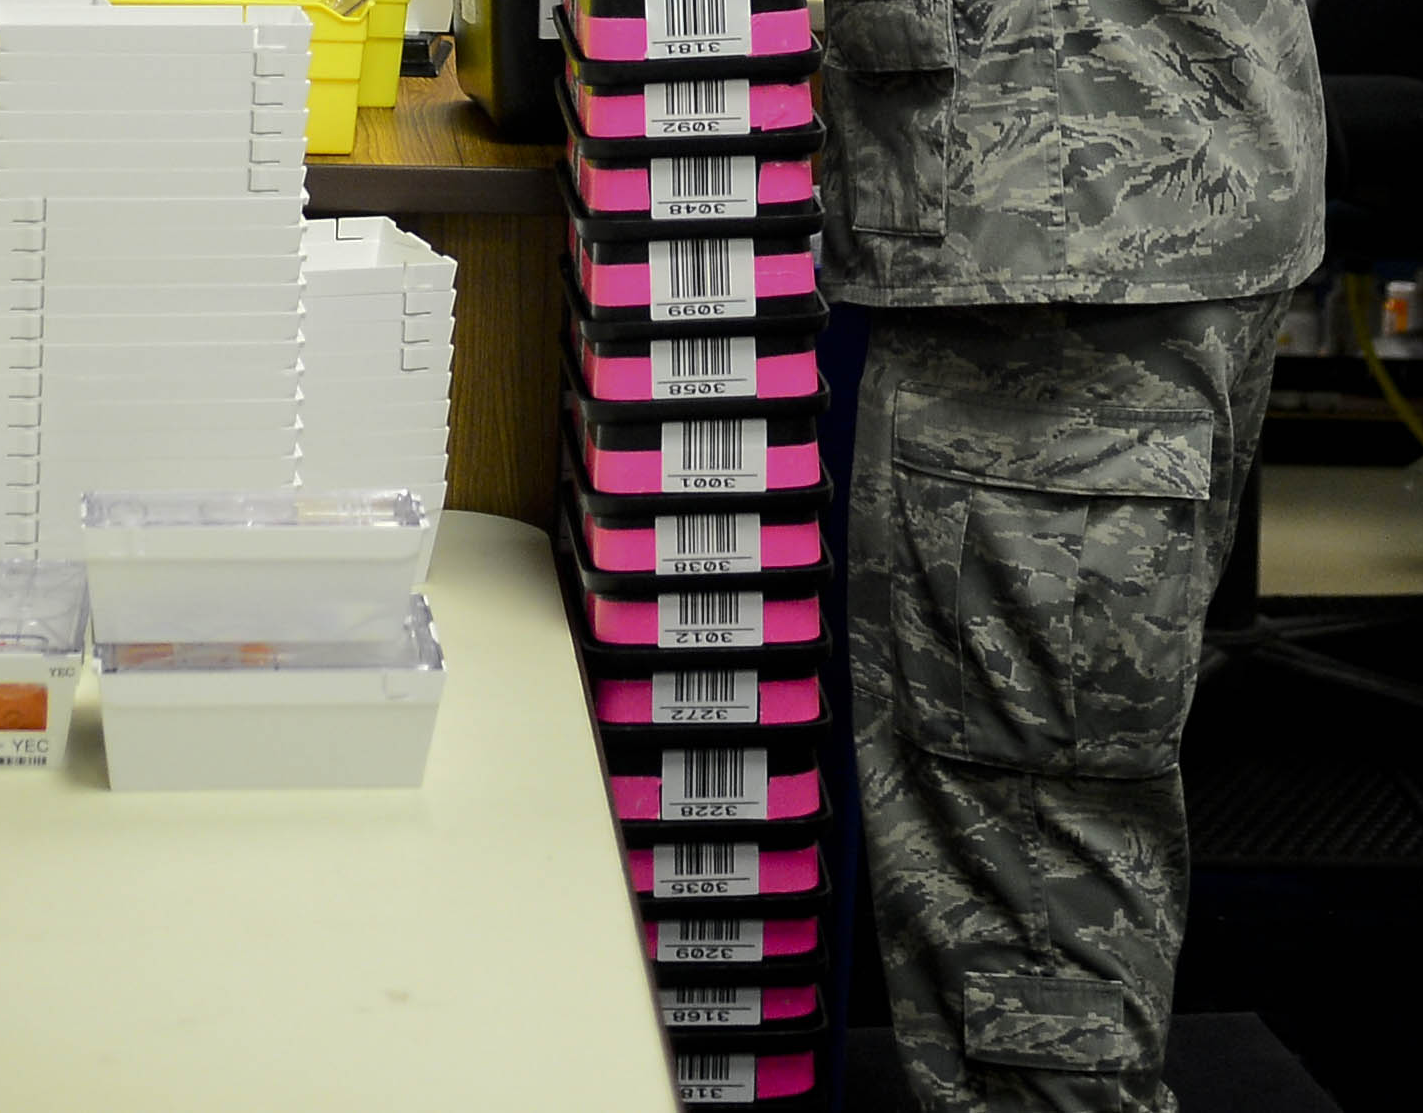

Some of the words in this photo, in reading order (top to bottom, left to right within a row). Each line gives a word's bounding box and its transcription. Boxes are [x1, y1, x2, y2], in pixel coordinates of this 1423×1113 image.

[665, 41, 721, 54] 3181
[662, 121, 720, 134] 3092
[669, 202, 726, 215] 3048
[667, 304, 725, 316] 3099
[668, 383, 725, 395] 3058
[679, 476, 737, 489] 3001
[674, 560, 731, 573] 3038
[676, 632, 733, 644] 3012
[671, 708, 728, 720] 3272
[12, 738, 48, 753] YEC
[680, 805, 737, 817] 3228
[671, 881, 728, 894] 3035
[675, 947, 733, 959] 3209
[672, 1010, 730, 1022] 3168
[681, 1087, 723, 1099] 318
